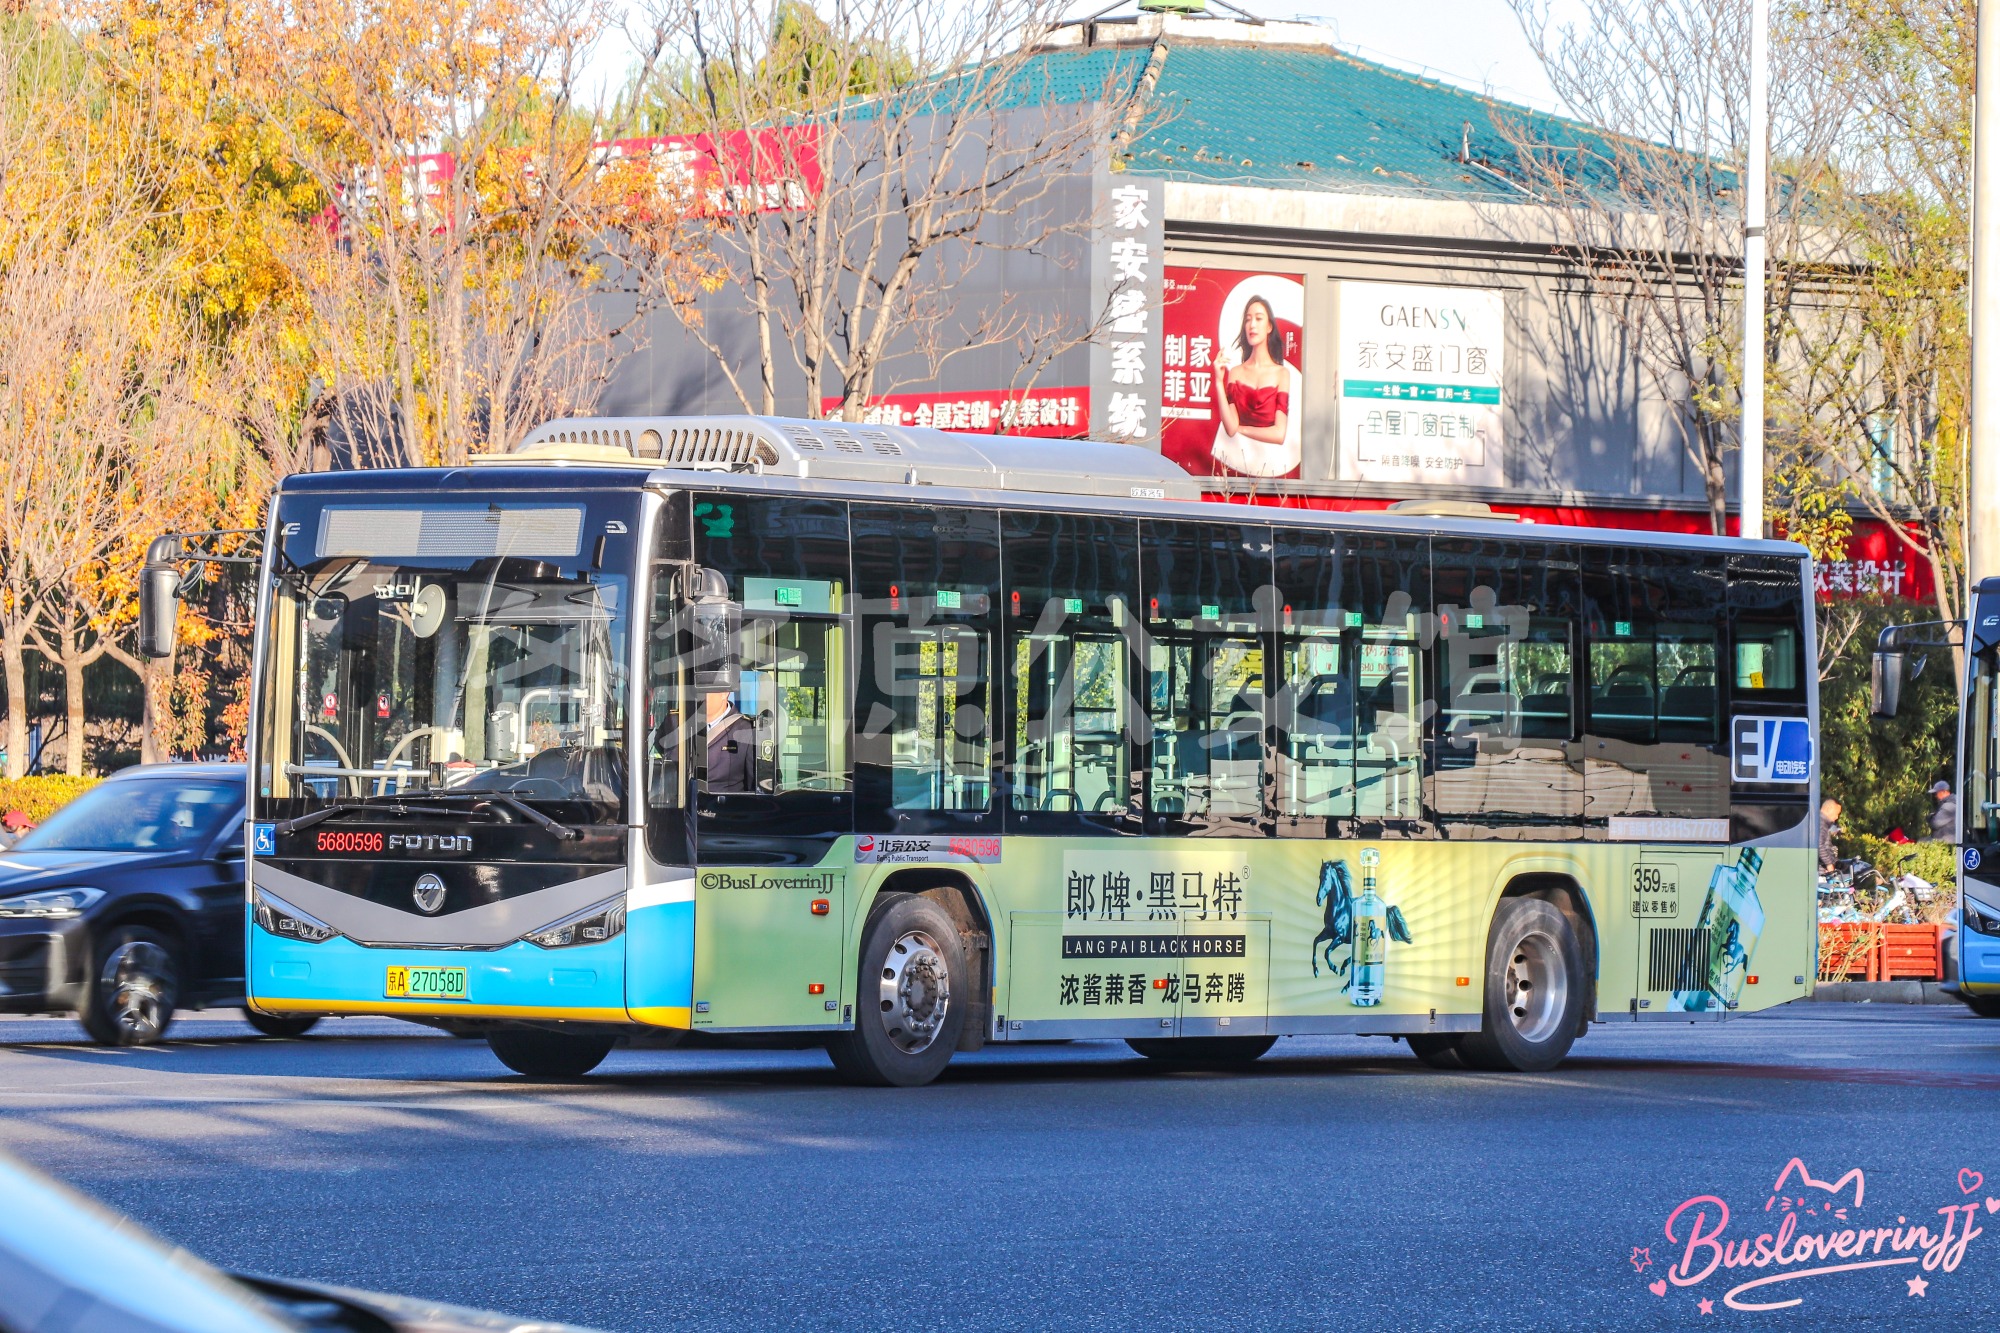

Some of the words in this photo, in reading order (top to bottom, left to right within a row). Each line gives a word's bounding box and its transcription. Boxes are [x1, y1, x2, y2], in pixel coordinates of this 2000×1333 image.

[1107, 184, 1150, 438] 家安盛系统
[1164, 334, 1212, 368] 制家
[1358, 341, 1487, 375] 家安盛门窗
[1163, 370, 1212, 403] 菲亚
[1366, 410, 1475, 438] 全屋门窗定制
[1425, 456, 1463, 470] 安全防护
[1733, 716, 1783, 780] EV
[1776, 760, 1807, 775] 电动汽车
[317, 832, 383, 851] 5680596
[389, 834, 473, 851] FOTON
[877, 839, 931, 852] 北京公交
[948, 838, 1000, 856] 5680596
[1067, 870, 1242, 921] 郎牌·黑马特
[1632, 900, 1677, 913] 建议零售价
[1065, 940, 1105, 954] LANG
[1110, 940, 1135, 954] PAI
[1140, 940, 1188, 954] BLACK
[1192, 939, 1243, 953] HORSE
[388, 971, 405, 991] 京A
[412, 971, 464, 992] 27058D
[1060, 973, 1147, 1006] 浓酱兼香
[1161, 972, 1245, 1004] 龙马奔腾
